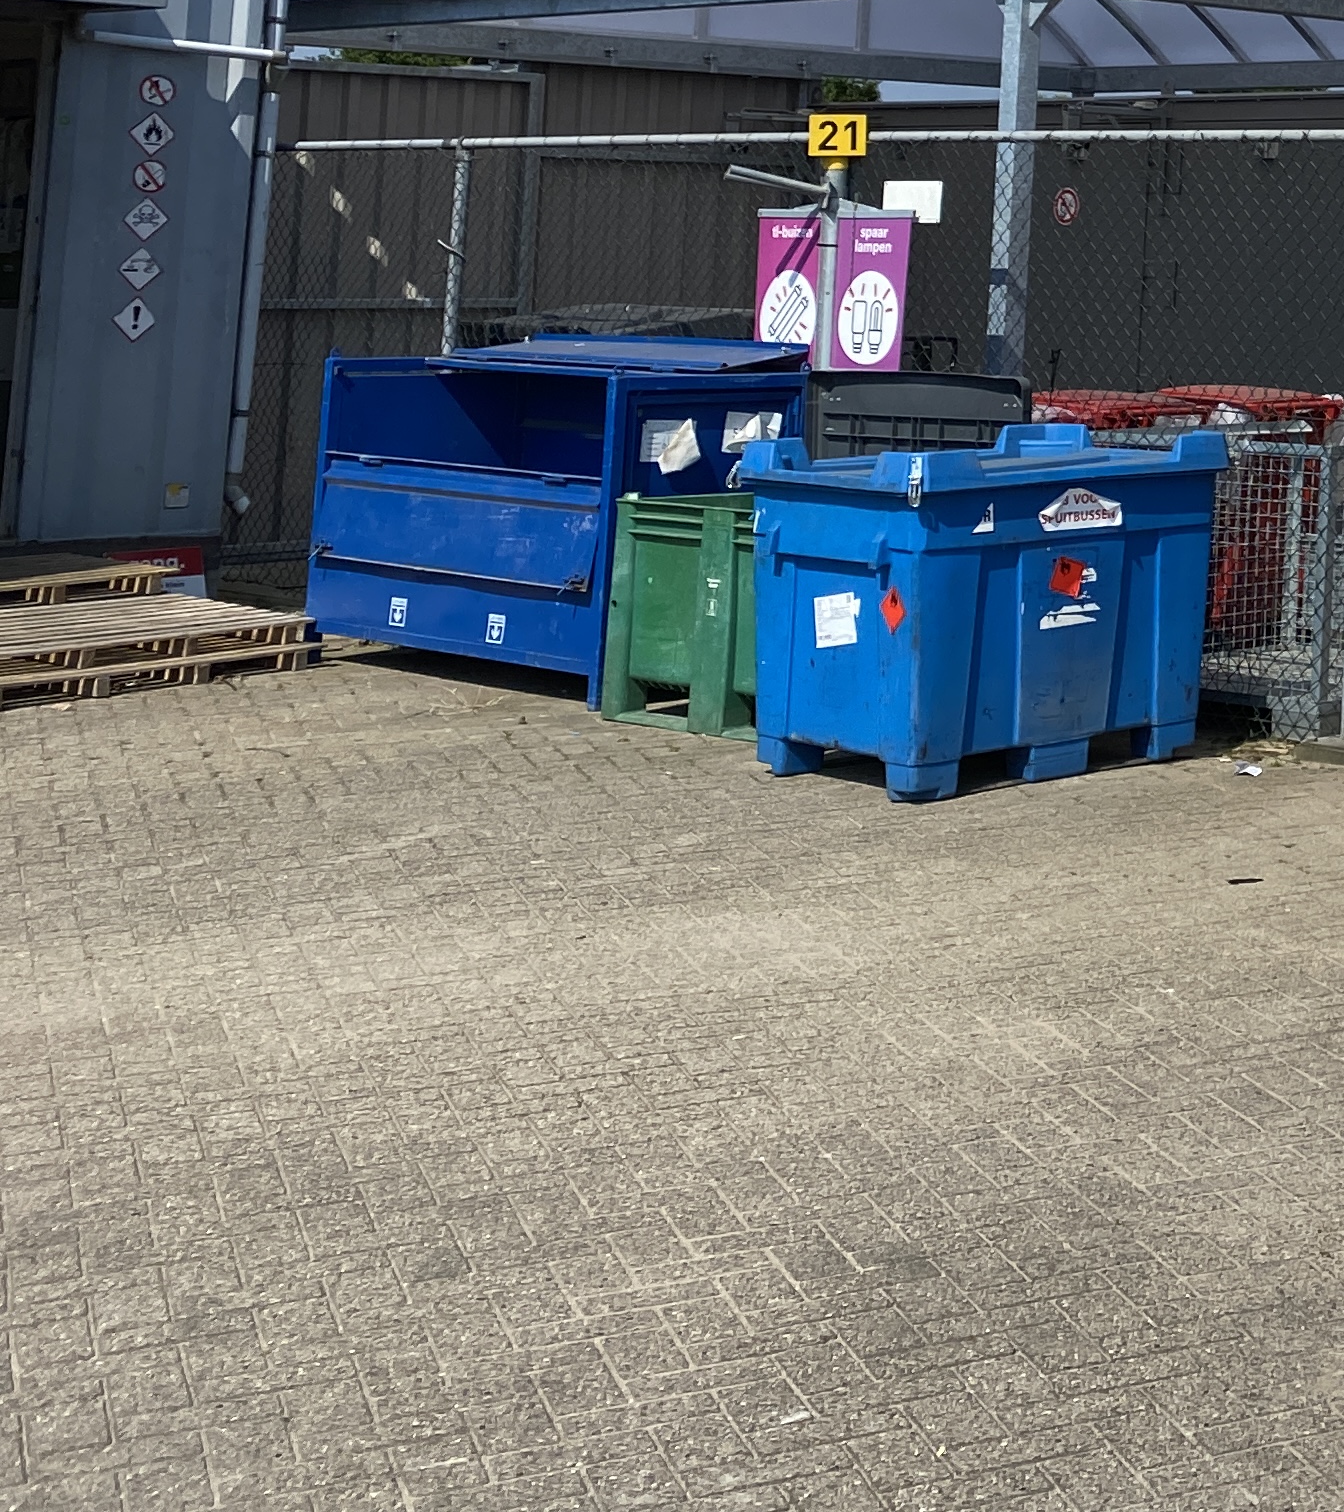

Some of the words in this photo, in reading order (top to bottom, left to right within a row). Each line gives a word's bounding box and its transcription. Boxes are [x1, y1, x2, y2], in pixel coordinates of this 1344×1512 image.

[817, 120, 858, 151] 21
[859, 226, 889, 240] spaar
[854, 239, 893, 255] lampen
